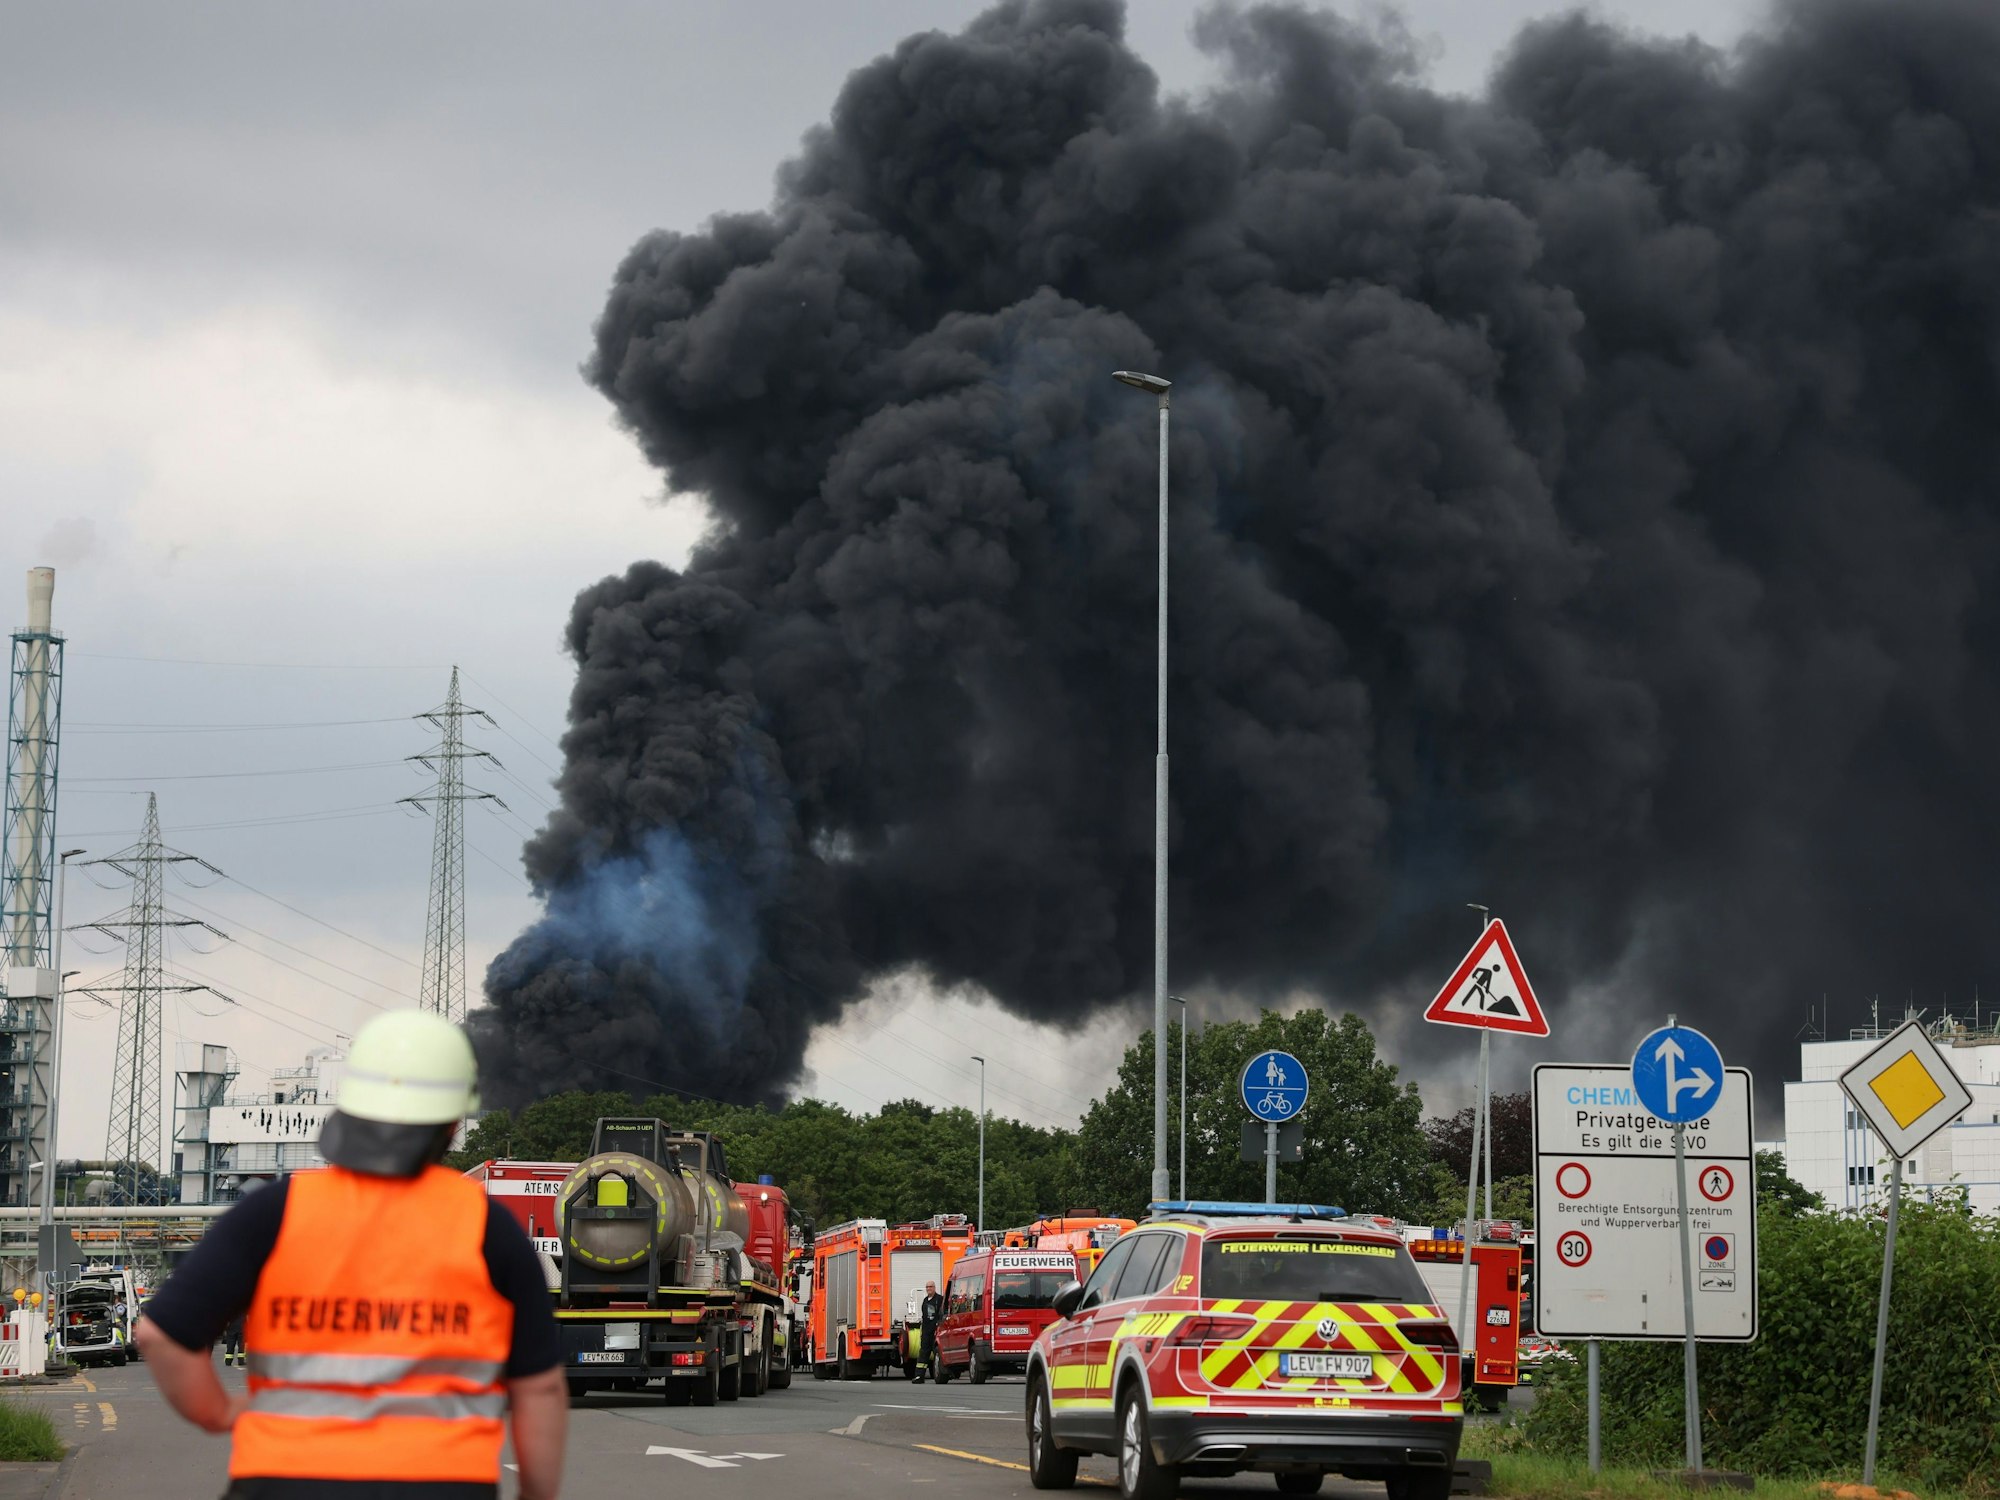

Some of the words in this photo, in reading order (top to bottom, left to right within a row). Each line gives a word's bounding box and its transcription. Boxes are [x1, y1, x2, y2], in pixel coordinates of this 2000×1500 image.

[1577, 1111, 1710, 1133] Privatgee
[1582, 1134, 1600, 1147] Es
[1608, 1135, 1632, 1151] gilt
[1640, 1135, 1662, 1149] die
[1671, 1136, 1706, 1149] SVO
[525, 1183, 559, 1194] ATEMS
[1558, 1203, 1619, 1215] Berechtigte
[1623, 1204, 1733, 1217] Entsorgunzentrum
[1581, 1218, 1600, 1227] und
[1605, 1218, 1681, 1230] Wupperverban
[1693, 1219, 1711, 1229] frei
[1221, 1243, 1309, 1254] FEUERWEHR
[1312, 1244, 1396, 1258] LEVERKUSEN
[1564, 1241, 1584, 1257] 30
[995, 1257, 1074, 1267] FEUERWEHR
[269, 1296, 471, 1335] FEUERWEHR
[1290, 1356, 1315, 1371] LEV
[1326, 1357, 1342, 1371] FW
[1346, 1358, 1370, 1372] 907
